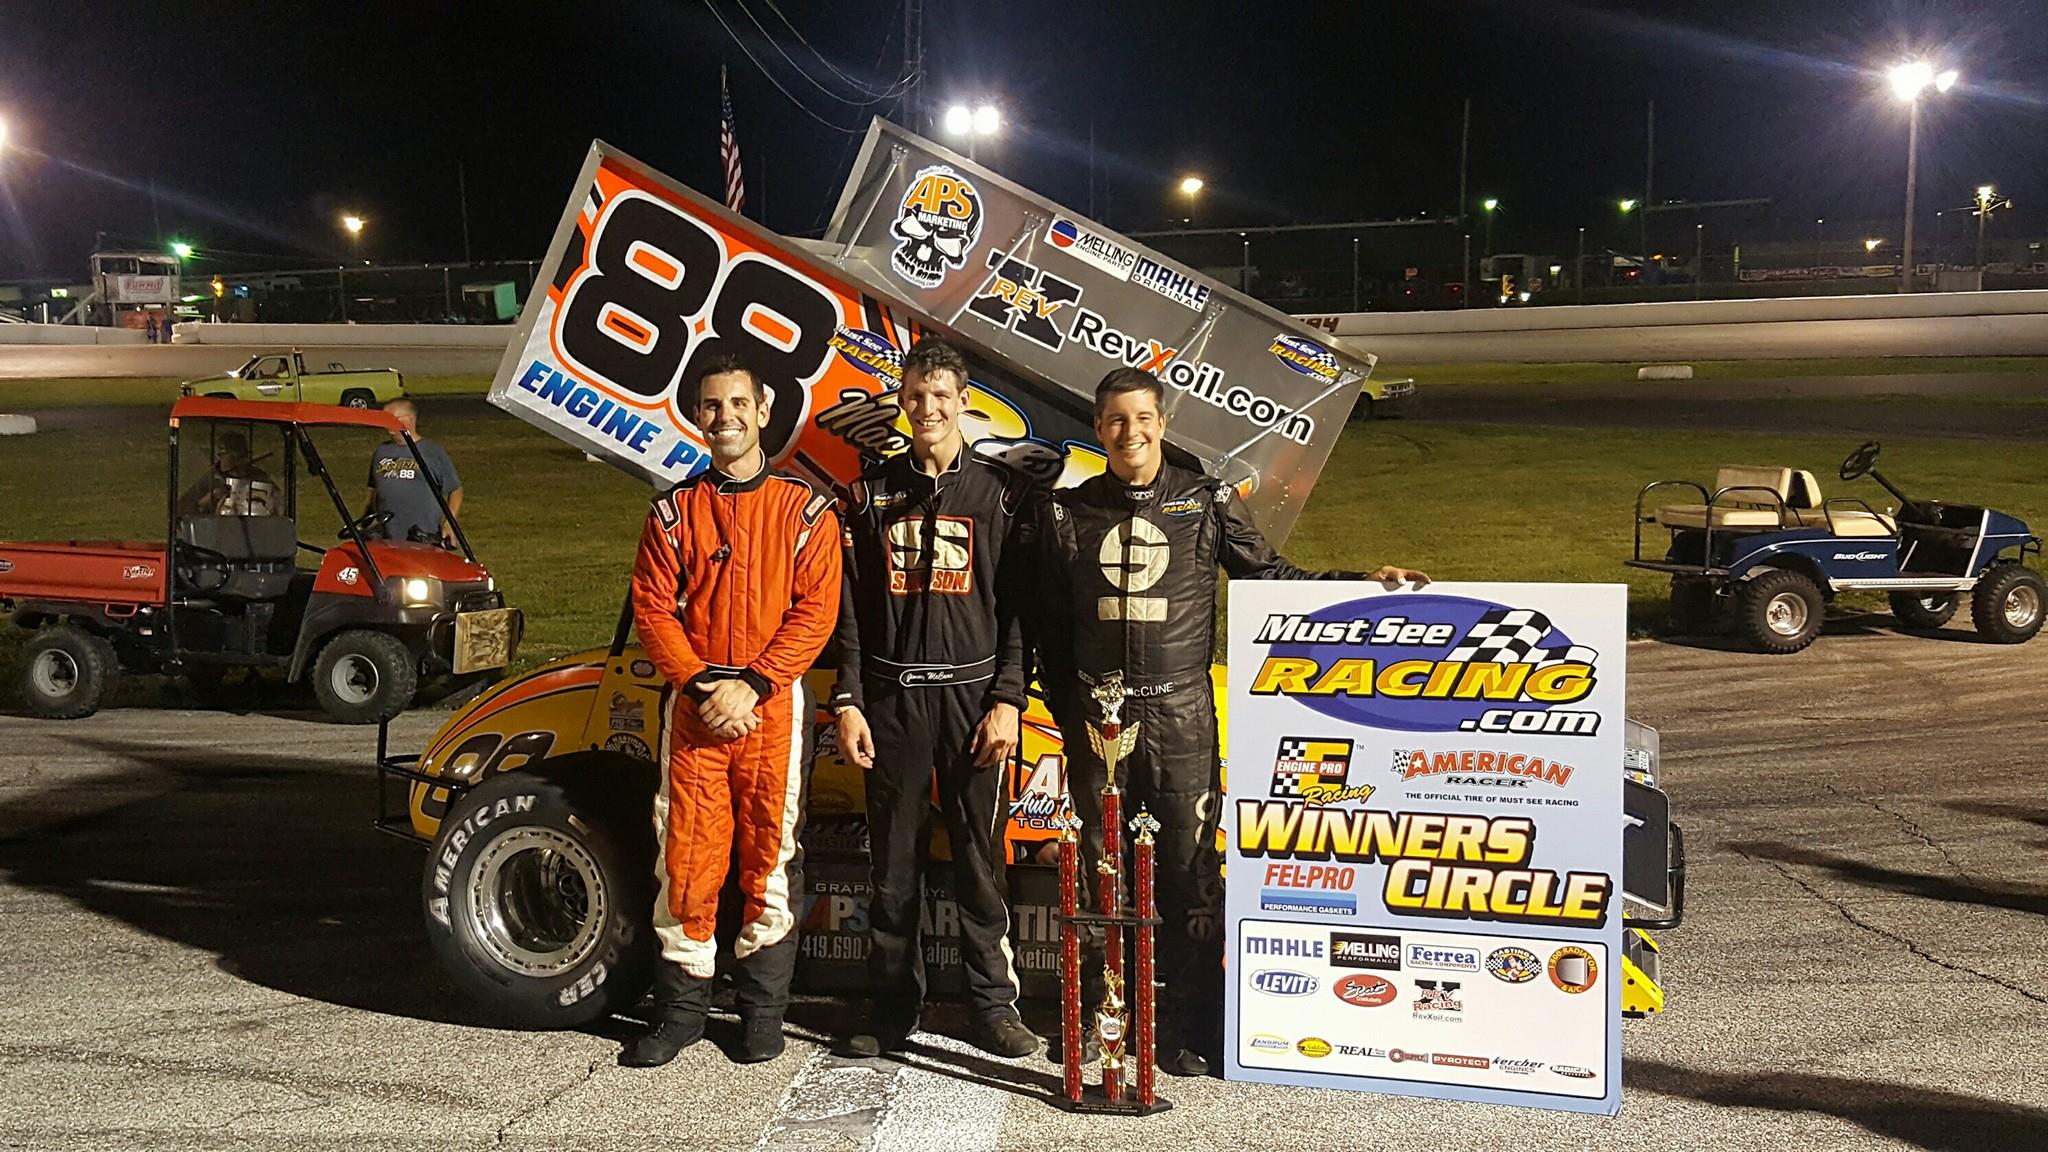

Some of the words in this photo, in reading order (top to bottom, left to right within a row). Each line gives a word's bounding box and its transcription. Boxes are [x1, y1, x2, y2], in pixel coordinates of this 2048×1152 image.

[904, 175, 974, 220] APS
[918, 212, 969, 231] MARKETING
[1075, 243, 1102, 259] ENGINE
[1102, 256, 1126, 271] PARTS
[1079, 233, 1135, 267] MELLING
[1133, 274, 1201, 311] ORIGINAL
[1136, 257, 1210, 304] MAHLE
[991, 279, 1061, 320] REV
[560, 196, 843, 460] 88
[834, 324, 865, 342] Must
[861, 338, 882, 352] See
[827, 336, 904, 379] RACING
[1268, 343, 1338, 378] RACING
[871, 372, 902, 389] .com
[1072, 308, 1314, 444] RevXoil.com
[517, 359, 663, 455] ENGINE
[399, 469, 415, 479] 88
[338, 566, 359, 581] 45
[1253, 614, 1369, 645] Must
[1371, 616, 1457, 646] See
[1250, 656, 1598, 704] RACING
[1458, 708, 1602, 737] .com
[1276, 761, 1317, 773] ENGINE
[1319, 763, 1344, 774] PRO
[1402, 750, 1574, 787] AMERICAN
[1301, 784, 1376, 809] Racing
[1445, 777, 1530, 788] RACER
[1009, 789, 1056, 817] Auto
[1424, 793, 1462, 801] OFFICIAL
[1500, 796, 1523, 804] MUST
[1237, 799, 1537, 867] WINNERS
[429, 795, 537, 935] AMERICAN
[1264, 864, 1355, 890] FEL-PRO
[1384, 859, 1614, 927] CIRCLE
[1264, 903, 1318, 913] PERFORMANCE
[1318, 906, 1353, 915] GASKETS
[1246, 936, 1323, 958] MAHLE
[1339, 941, 1400, 959] MELLING
[1411, 946, 1476, 964] Ferrea
[1337, 955, 1399, 964] PERFORMANCE
[1249, 969, 1319, 995] CLEVITE
[1412, 1012, 1463, 1022] RevXoil.com
[1413, 1000, 1461, 1012] Racing
[1339, 1045, 1373, 1056] REAL
[1434, 1056, 1488, 1066] PYROTECT
[1492, 1057, 1545, 1068] kercher
